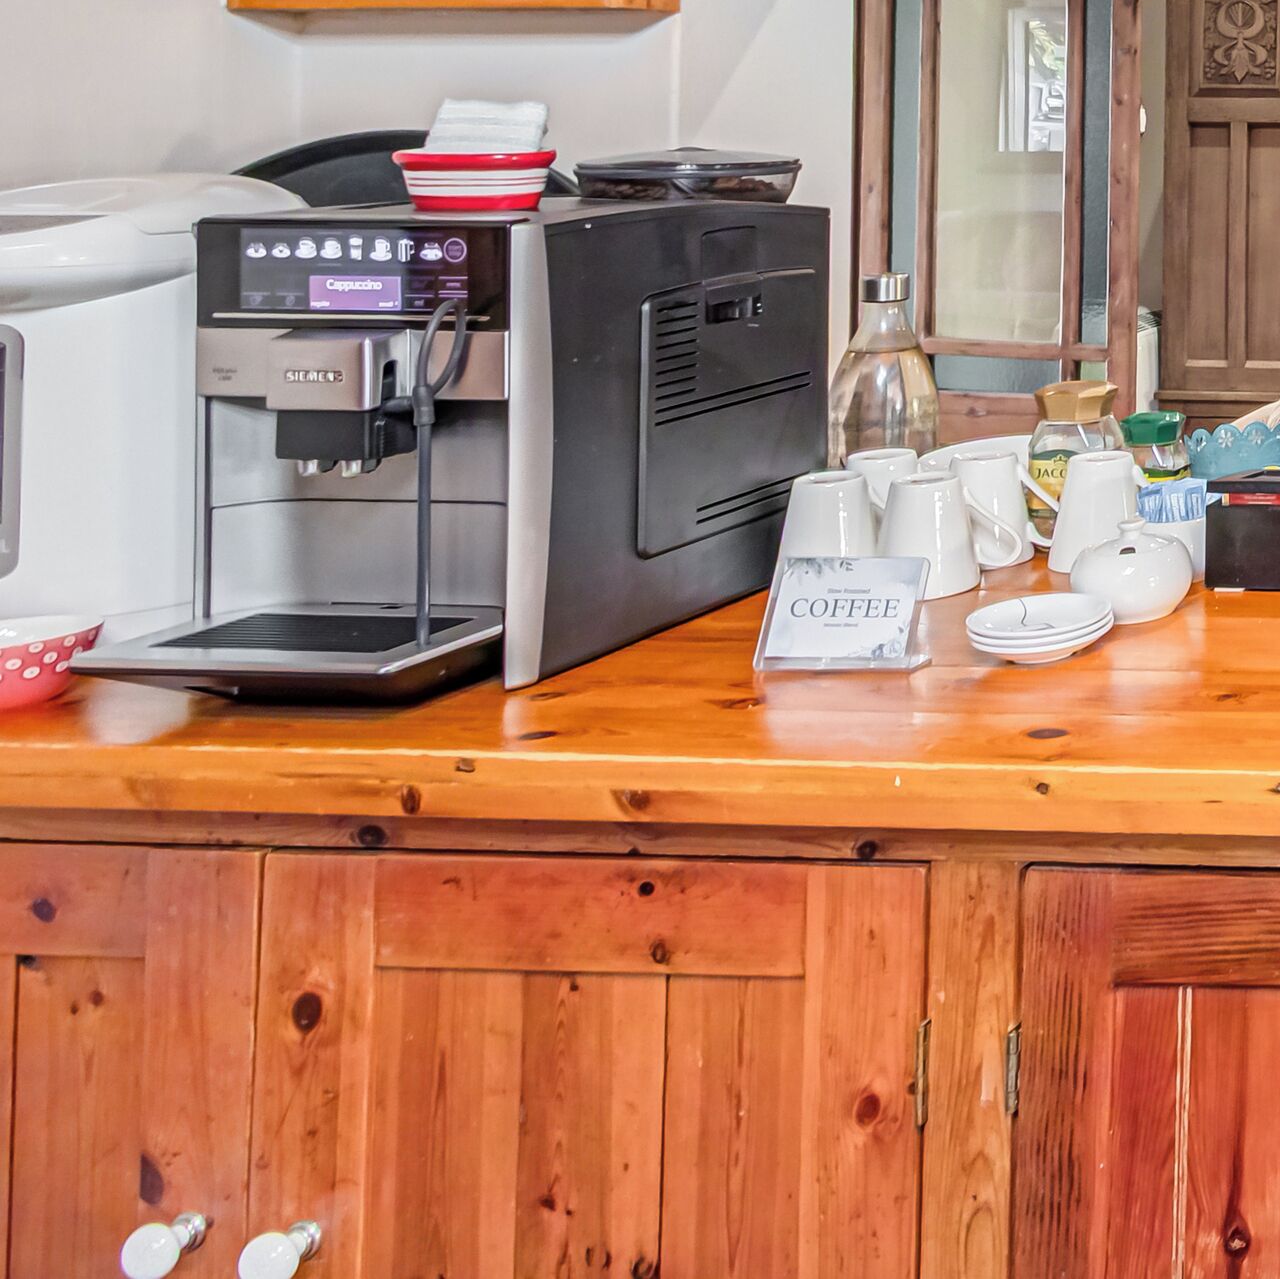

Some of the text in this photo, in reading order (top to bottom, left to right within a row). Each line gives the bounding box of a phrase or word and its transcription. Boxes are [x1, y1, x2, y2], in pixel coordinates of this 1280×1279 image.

[326, 279, 383, 291] Cappuccino
[285, 370, 344, 382] SIEMENS
[790, 598, 900, 619] COFFEE
